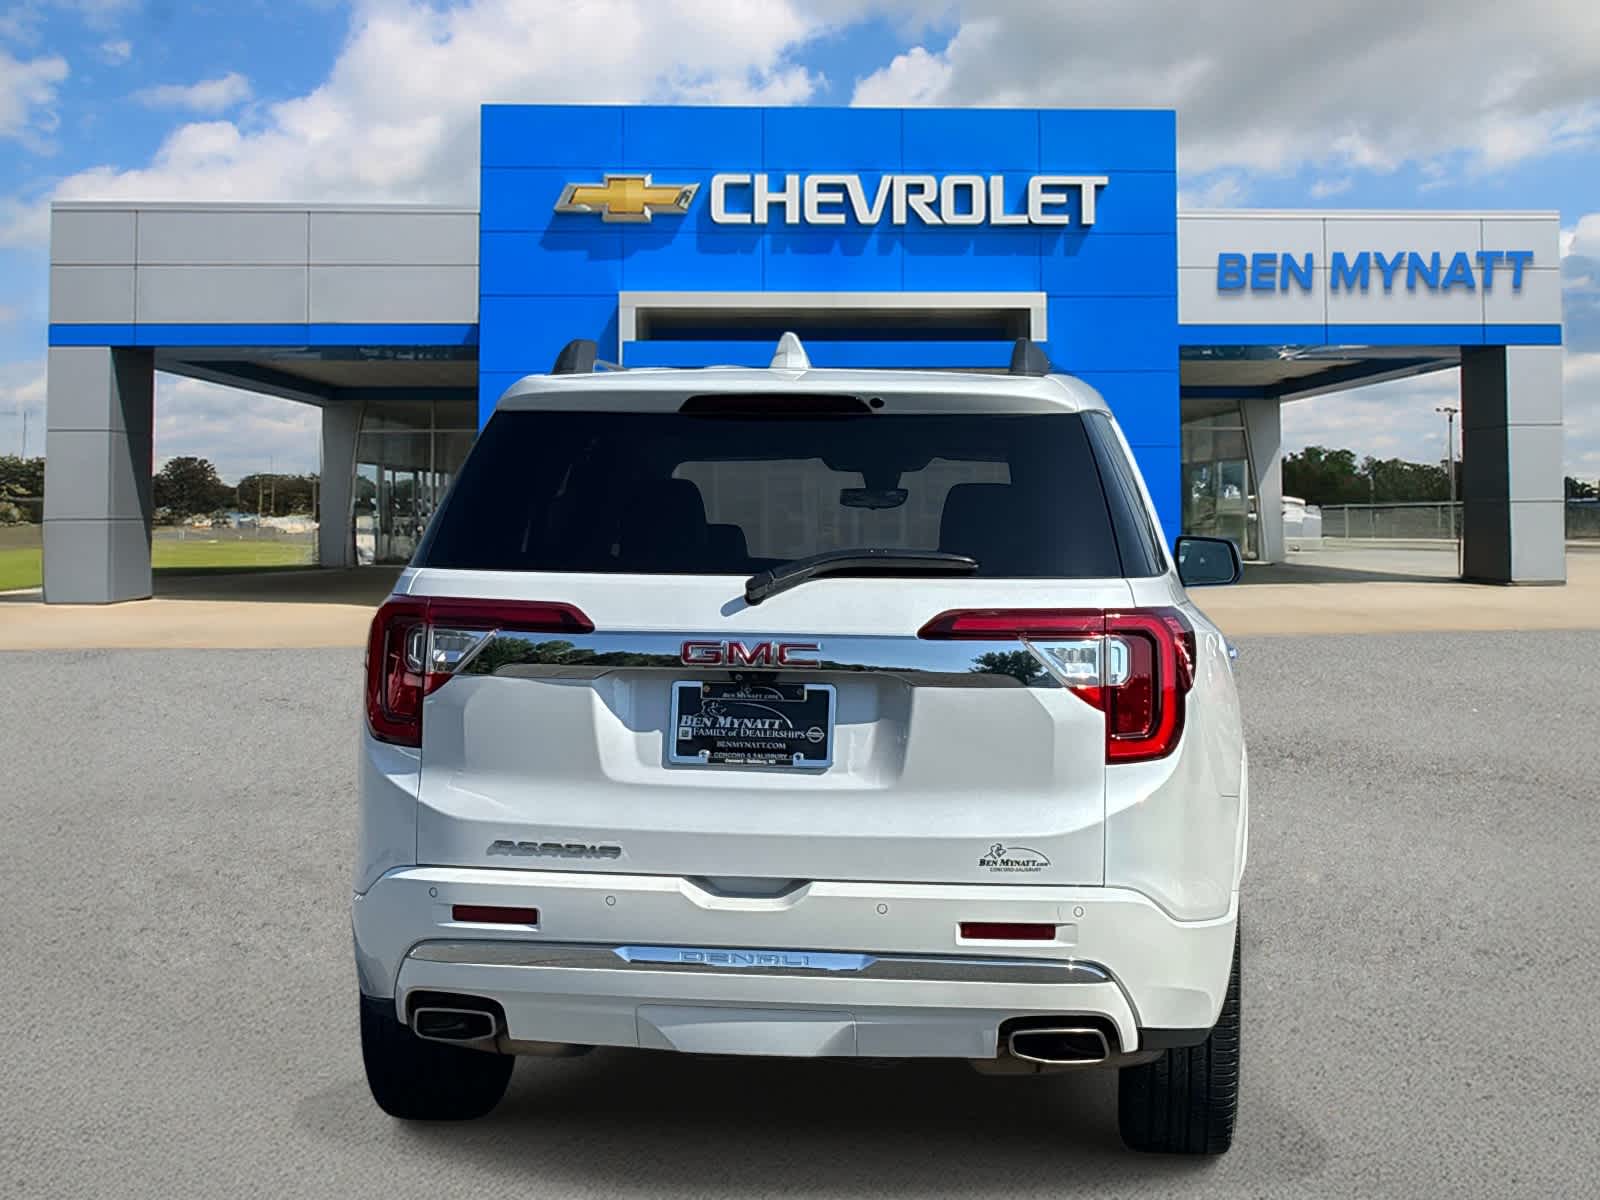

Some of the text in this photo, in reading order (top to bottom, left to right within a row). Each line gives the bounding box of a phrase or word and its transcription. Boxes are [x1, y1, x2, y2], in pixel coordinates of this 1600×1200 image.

[710, 173, 1108, 225] CHEVROLET
[1217, 250, 1534, 291] BEN MYNATT
[681, 640, 821, 669] GMC
[680, 715, 783, 729] BEN MYNATT
[693, 727, 806, 740] FAMILY of DEALERSHIPS
[716, 740, 787, 750] BENMYNATT.COM
[979, 858, 999, 867] BEN
[679, 951, 809, 967] DENALI
